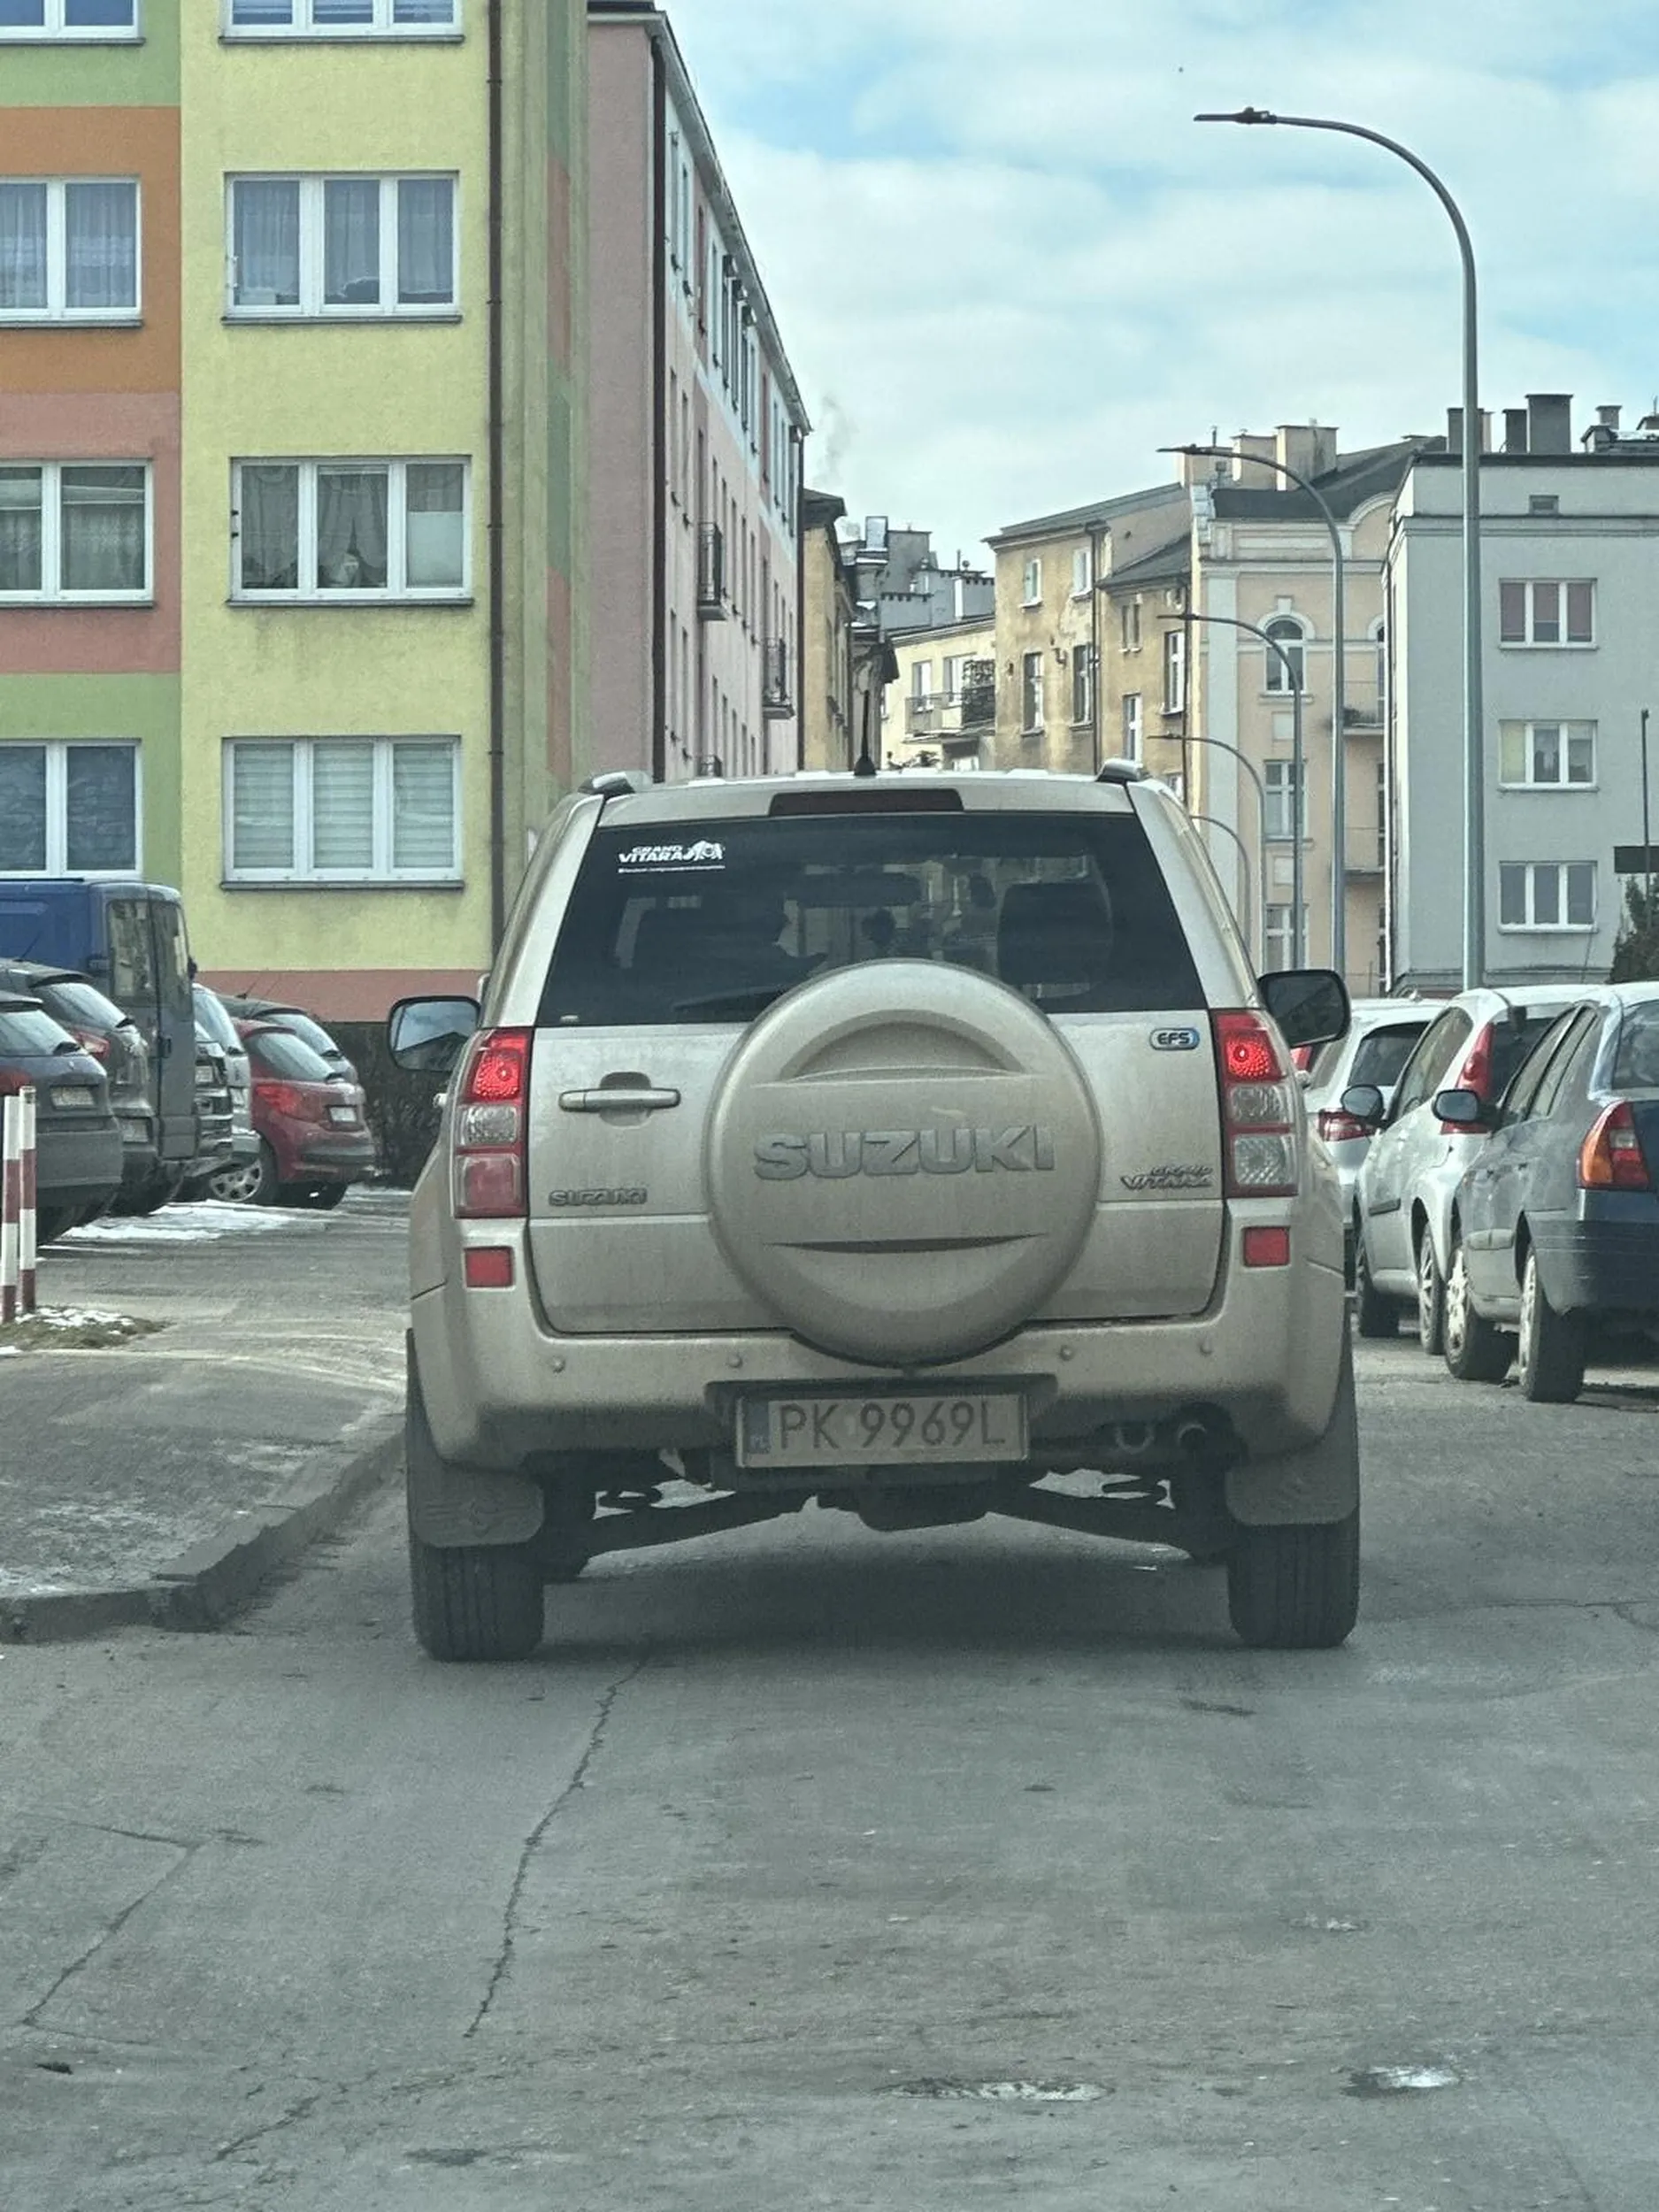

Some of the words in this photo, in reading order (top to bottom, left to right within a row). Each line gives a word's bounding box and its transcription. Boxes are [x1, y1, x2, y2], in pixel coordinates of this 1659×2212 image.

[618, 851, 683, 863] VITARA
[1157, 1032, 1190, 1045] EFS
[753, 1125, 1056, 1181] SUZUKI
[548, 1187, 648, 1206] SUZUKI
[780, 1403, 840, 1449] PK
[859, 1401, 1006, 1448] 9969L
